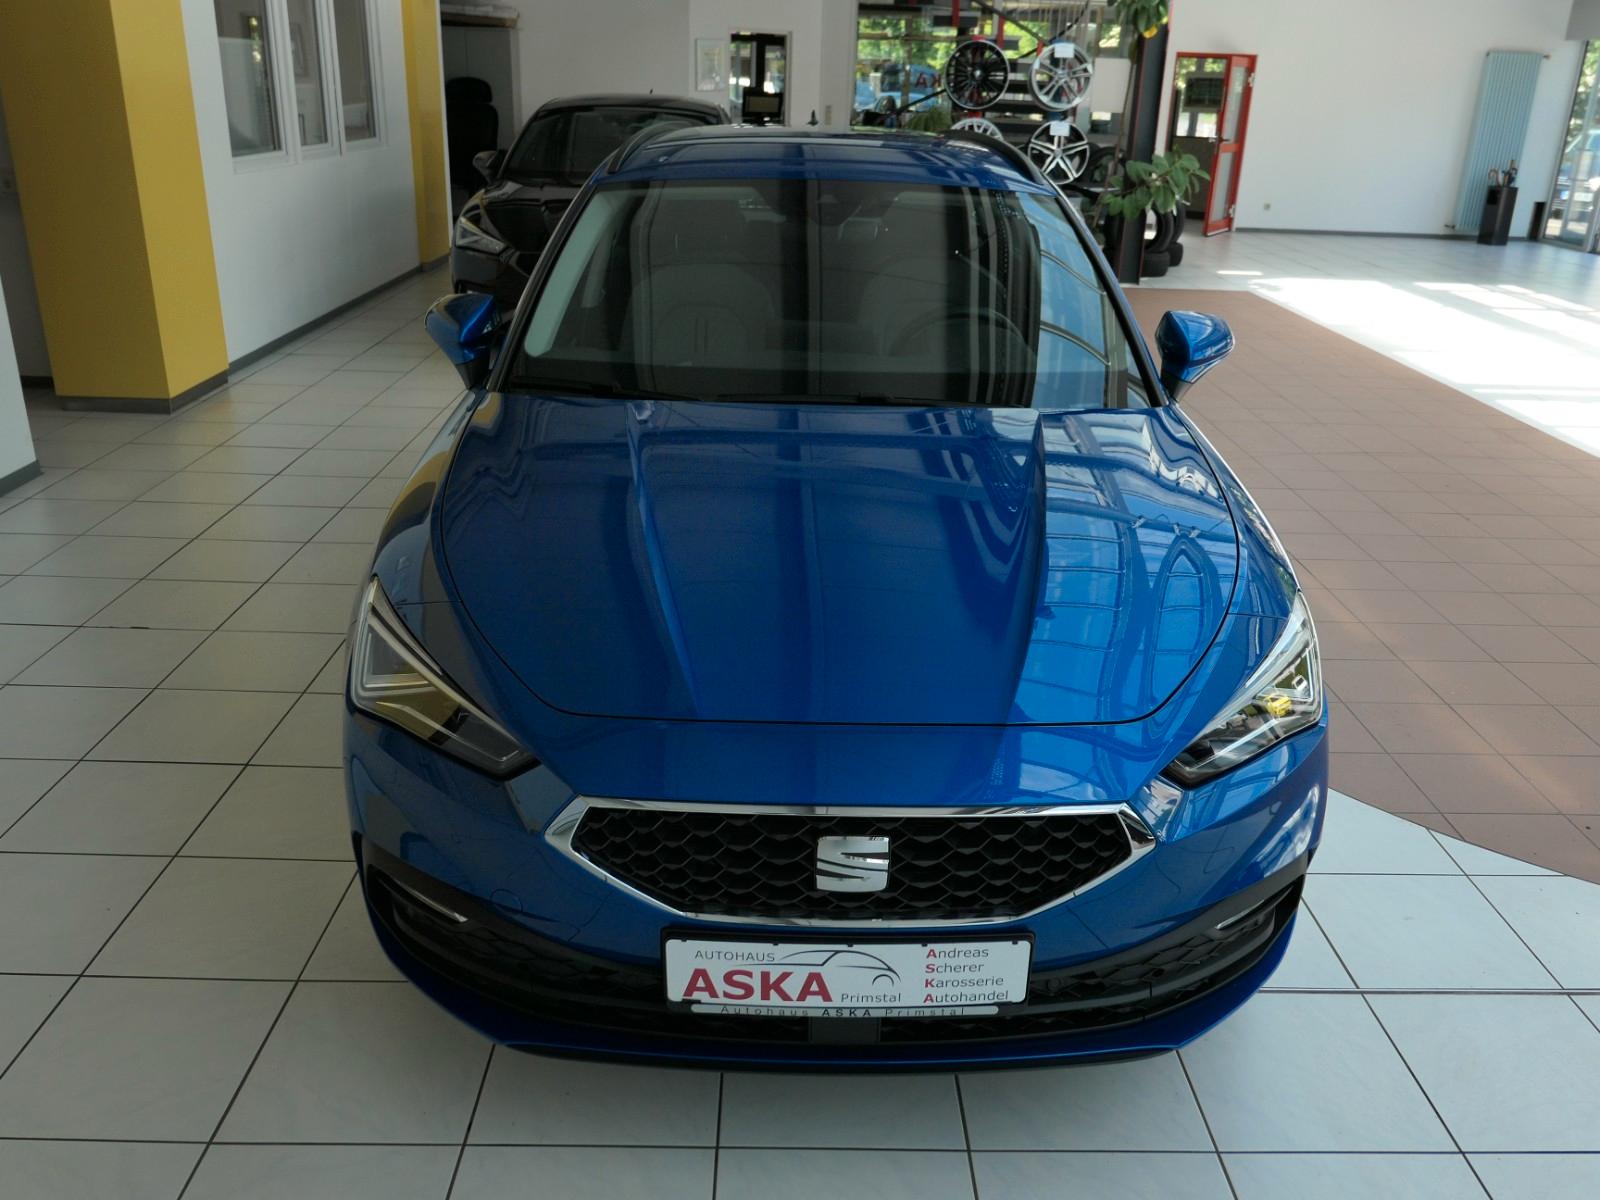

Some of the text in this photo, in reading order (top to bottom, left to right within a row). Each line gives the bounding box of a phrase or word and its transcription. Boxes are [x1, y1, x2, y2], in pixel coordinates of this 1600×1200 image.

[694, 950, 775, 962] AUTOHAUS
[926, 948, 989, 959] Andreas
[924, 963, 984, 974] Scherer
[682, 968, 833, 1002] ASKA
[924, 976, 1004, 988] Karosserie
[841, 993, 901, 1003] Primstal
[923, 990, 1009, 1004] Autohandel
[720, 1005, 965, 1017] Autohaus ASKA Primstal
